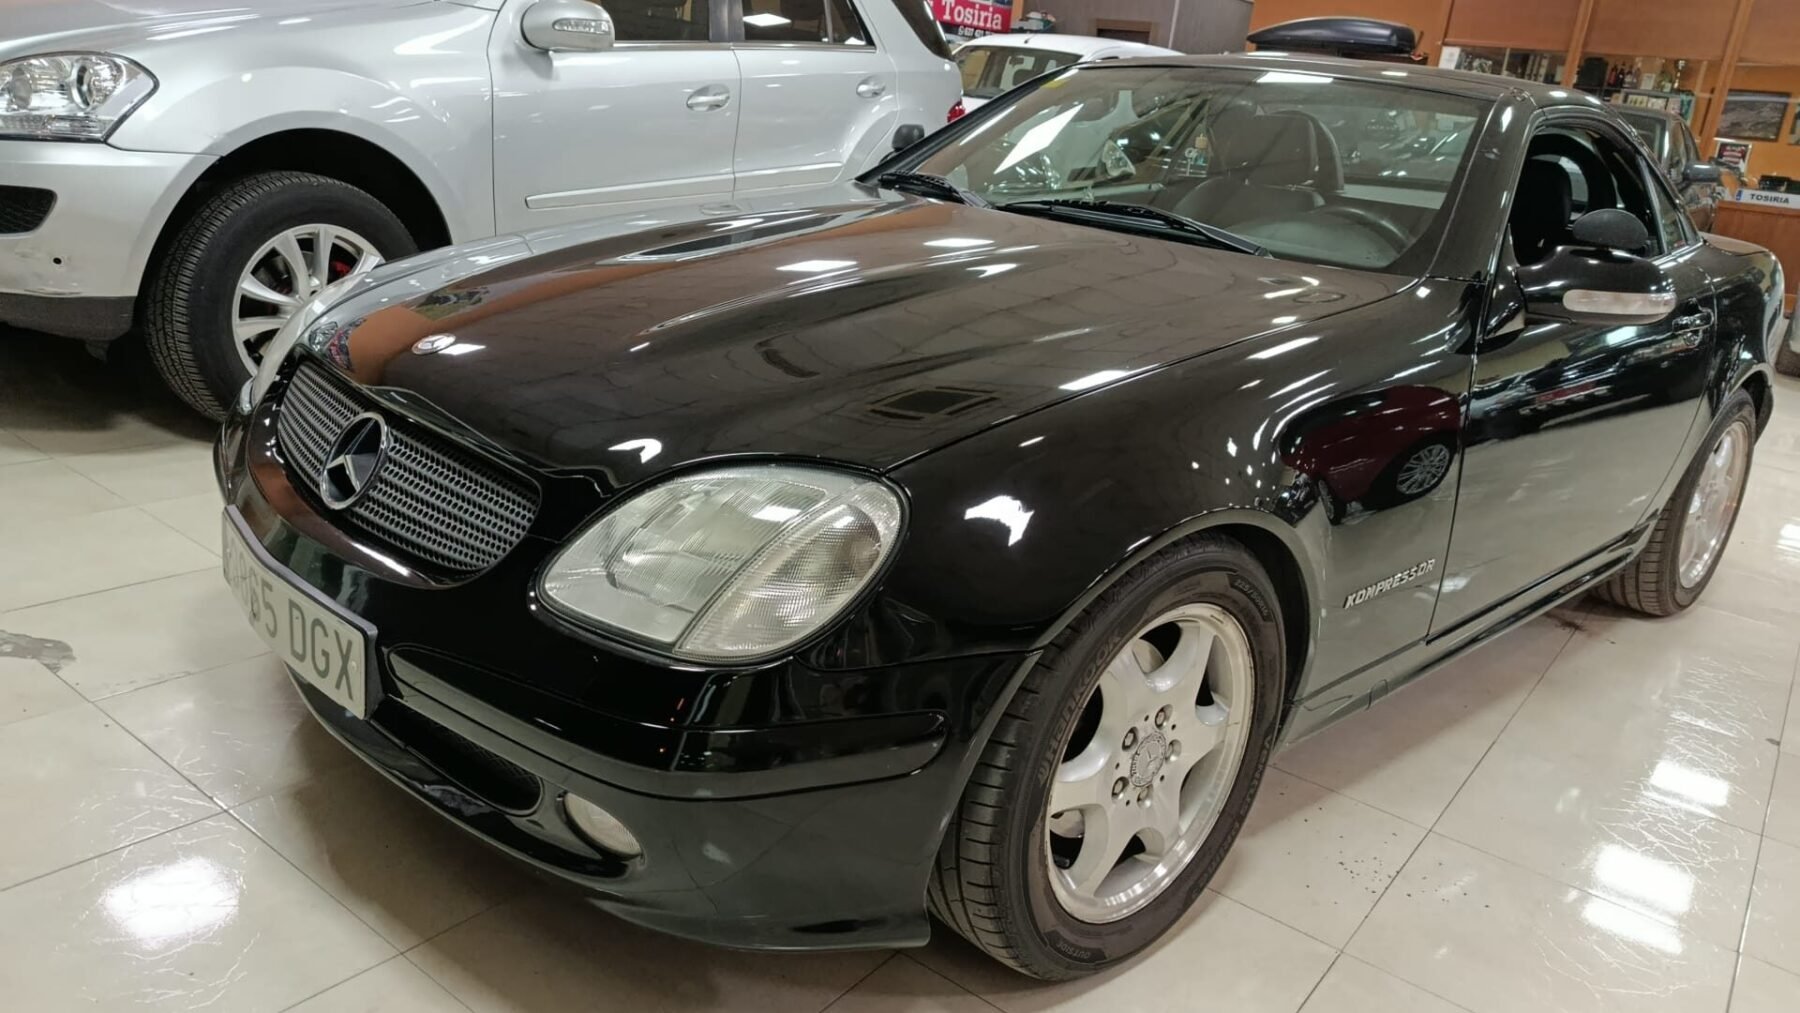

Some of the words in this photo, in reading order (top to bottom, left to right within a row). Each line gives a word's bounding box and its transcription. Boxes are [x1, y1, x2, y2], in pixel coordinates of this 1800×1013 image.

[942, 0, 1003, 30] Tosiria
[1750, 193, 1790, 204] TOSIRIA
[1343, 558, 1436, 610] KOMPRESSOR
[288, 599, 354, 701] DGX
